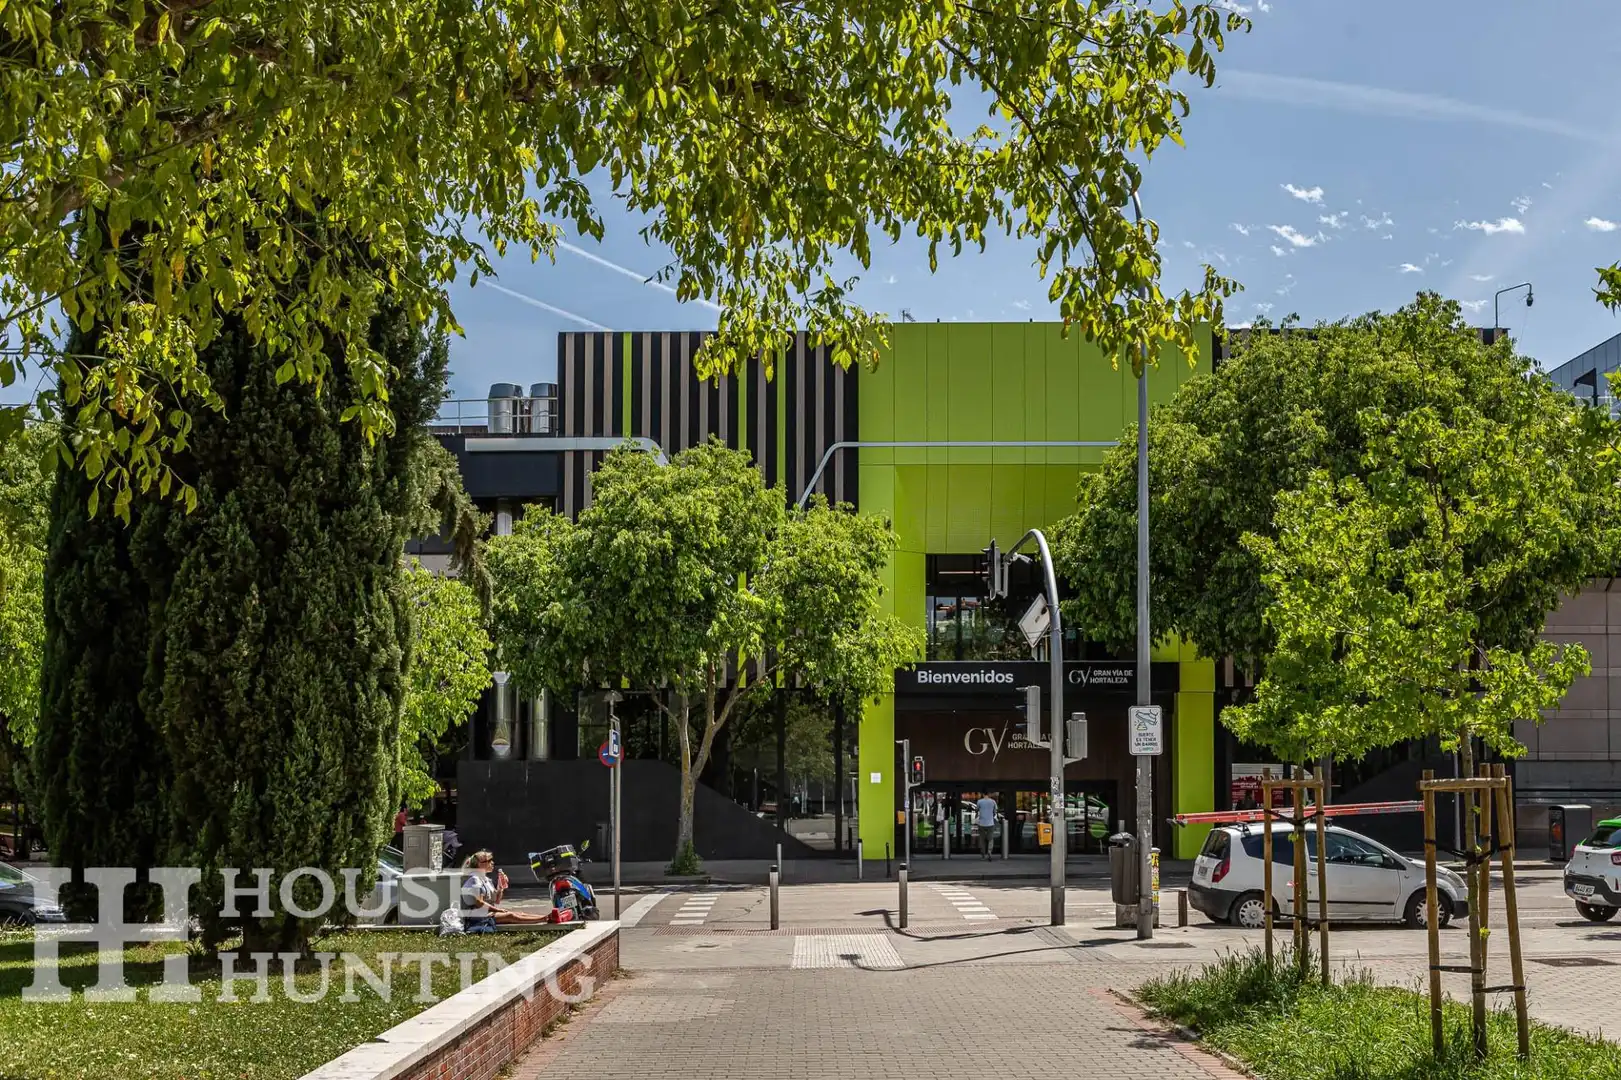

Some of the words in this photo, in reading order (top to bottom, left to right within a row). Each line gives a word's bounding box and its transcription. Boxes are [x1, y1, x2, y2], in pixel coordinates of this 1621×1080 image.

[917, 670, 1014, 684] Bienvenidos
[1093, 669, 1111, 677] GRAN
[1124, 669, 1133, 677] DE
